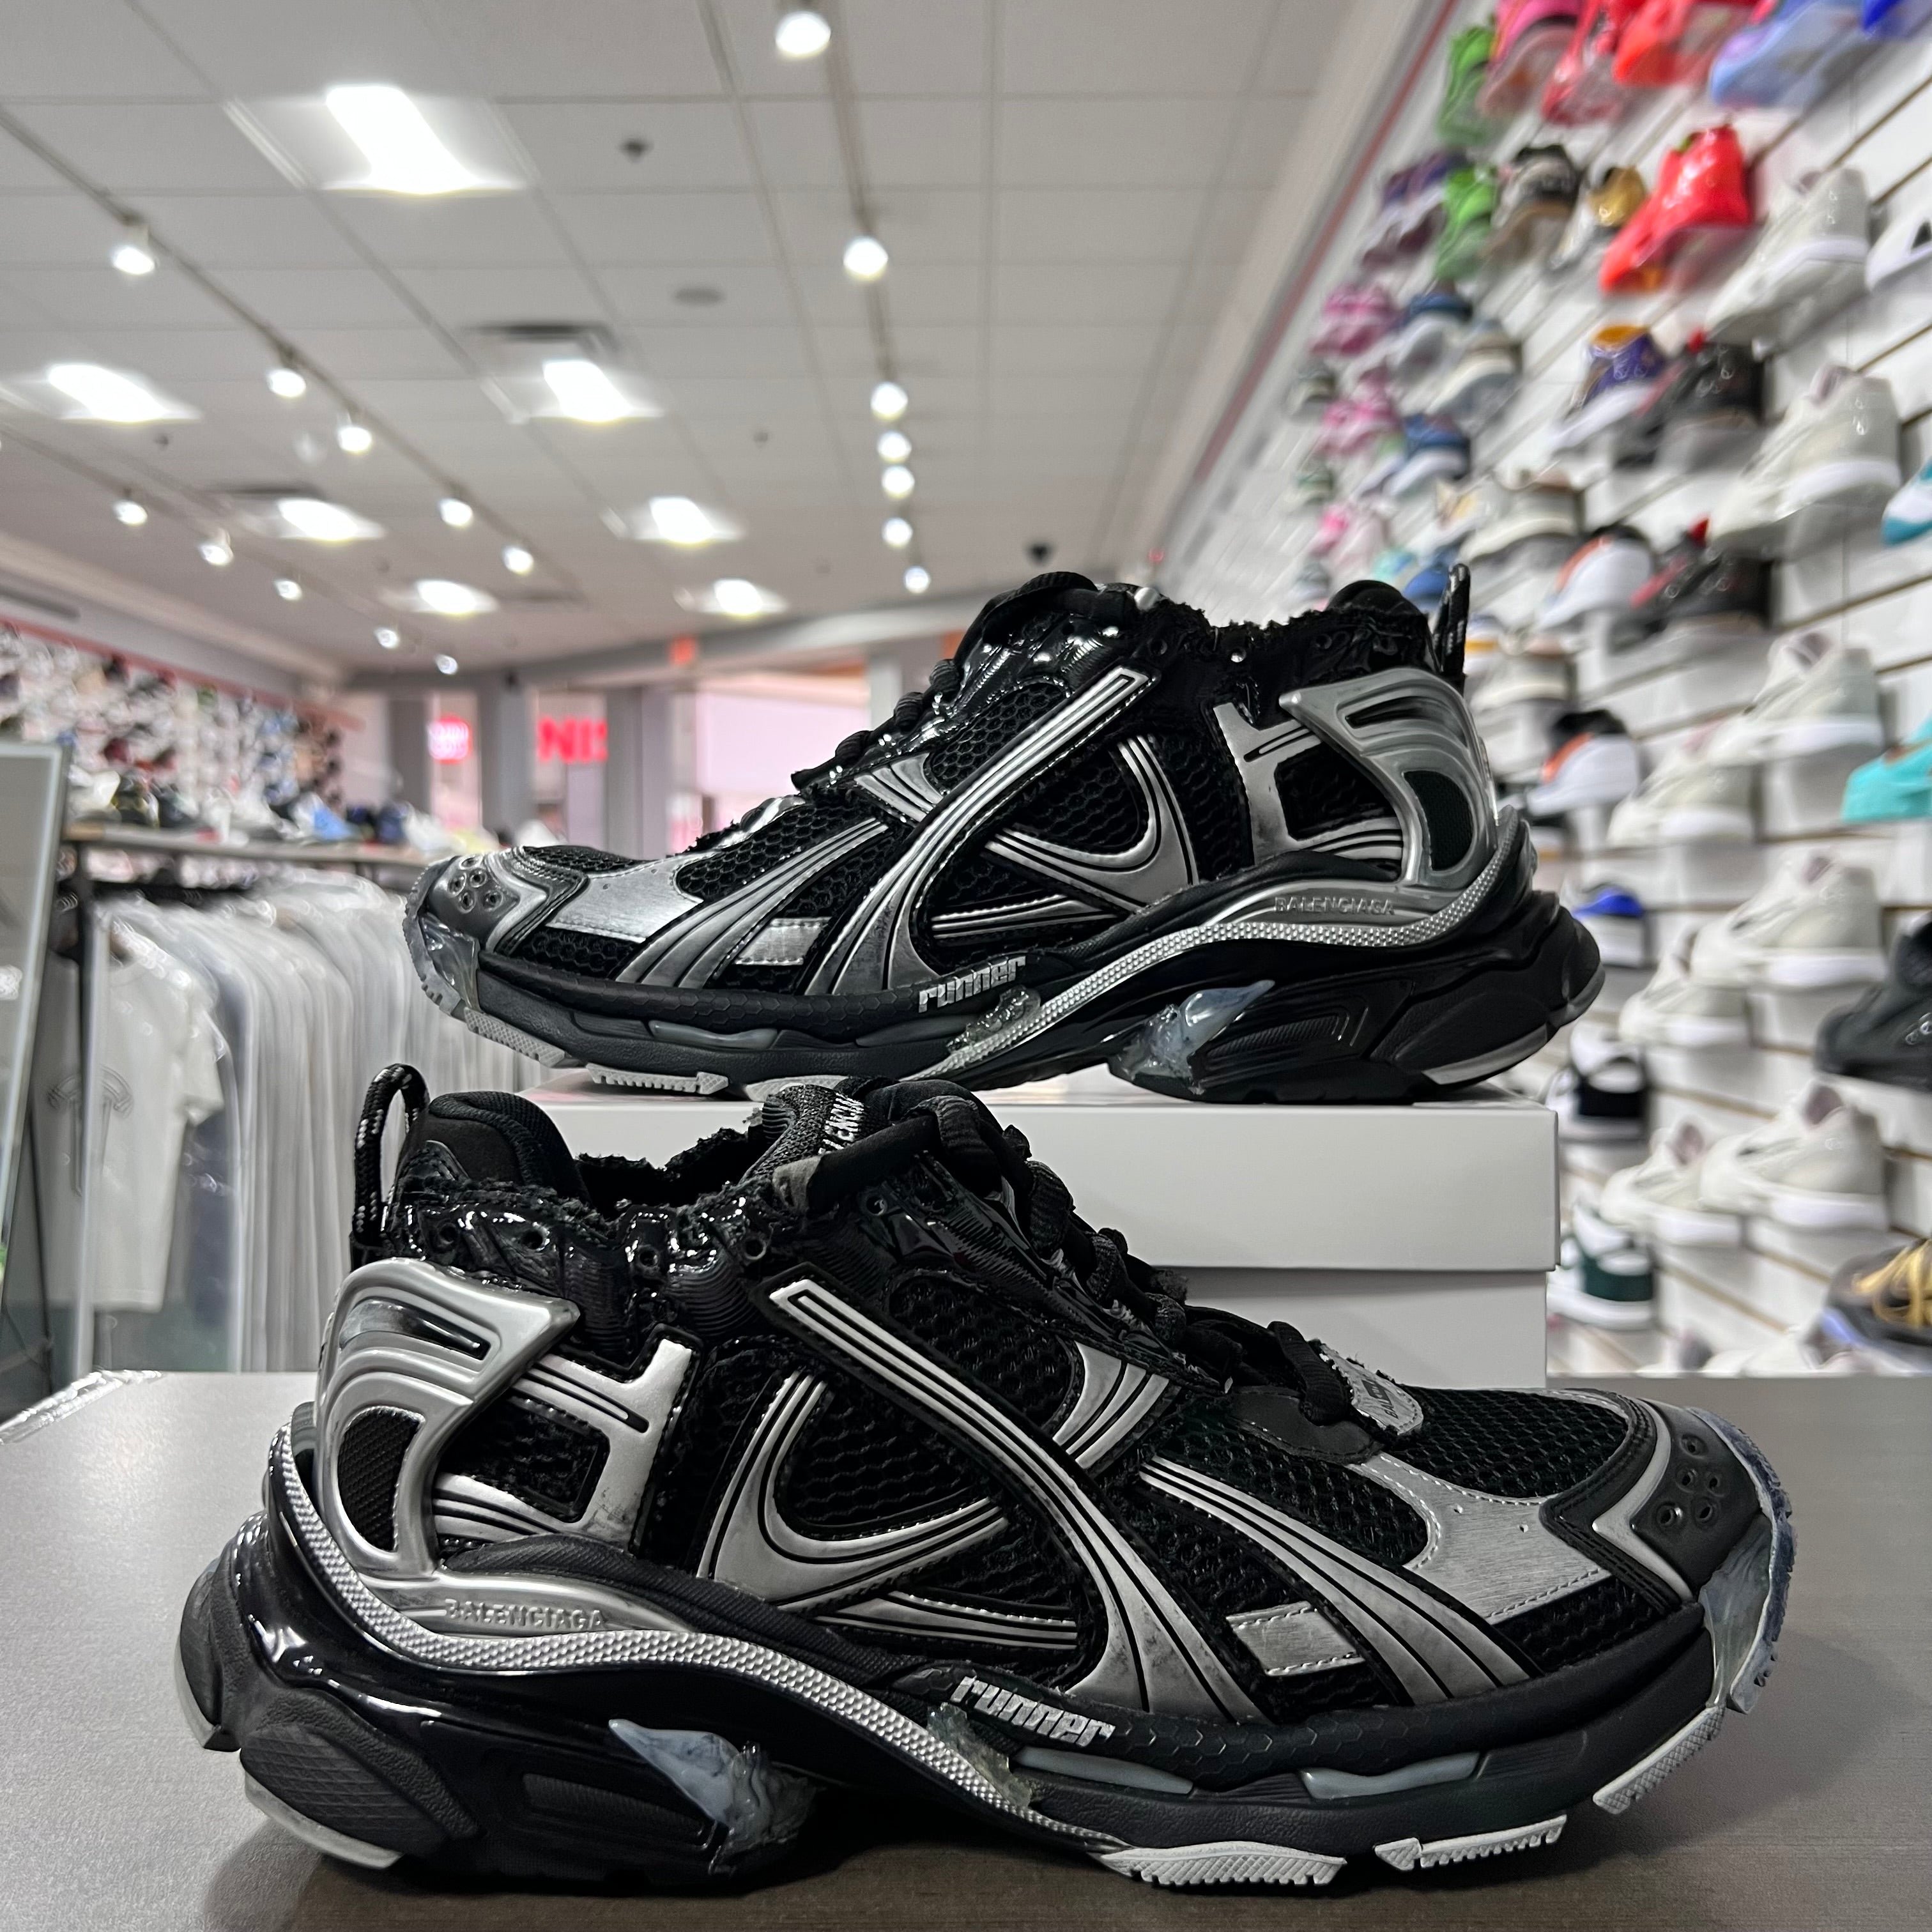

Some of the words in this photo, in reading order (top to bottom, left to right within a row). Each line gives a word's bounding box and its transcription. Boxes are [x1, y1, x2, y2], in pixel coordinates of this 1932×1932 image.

[1273, 896, 1395, 916] BALENCIAGA
[919, 956, 1026, 1013] runner
[445, 1598, 606, 1630] BALENCIAGA
[950, 1675, 1116, 1747] runner
